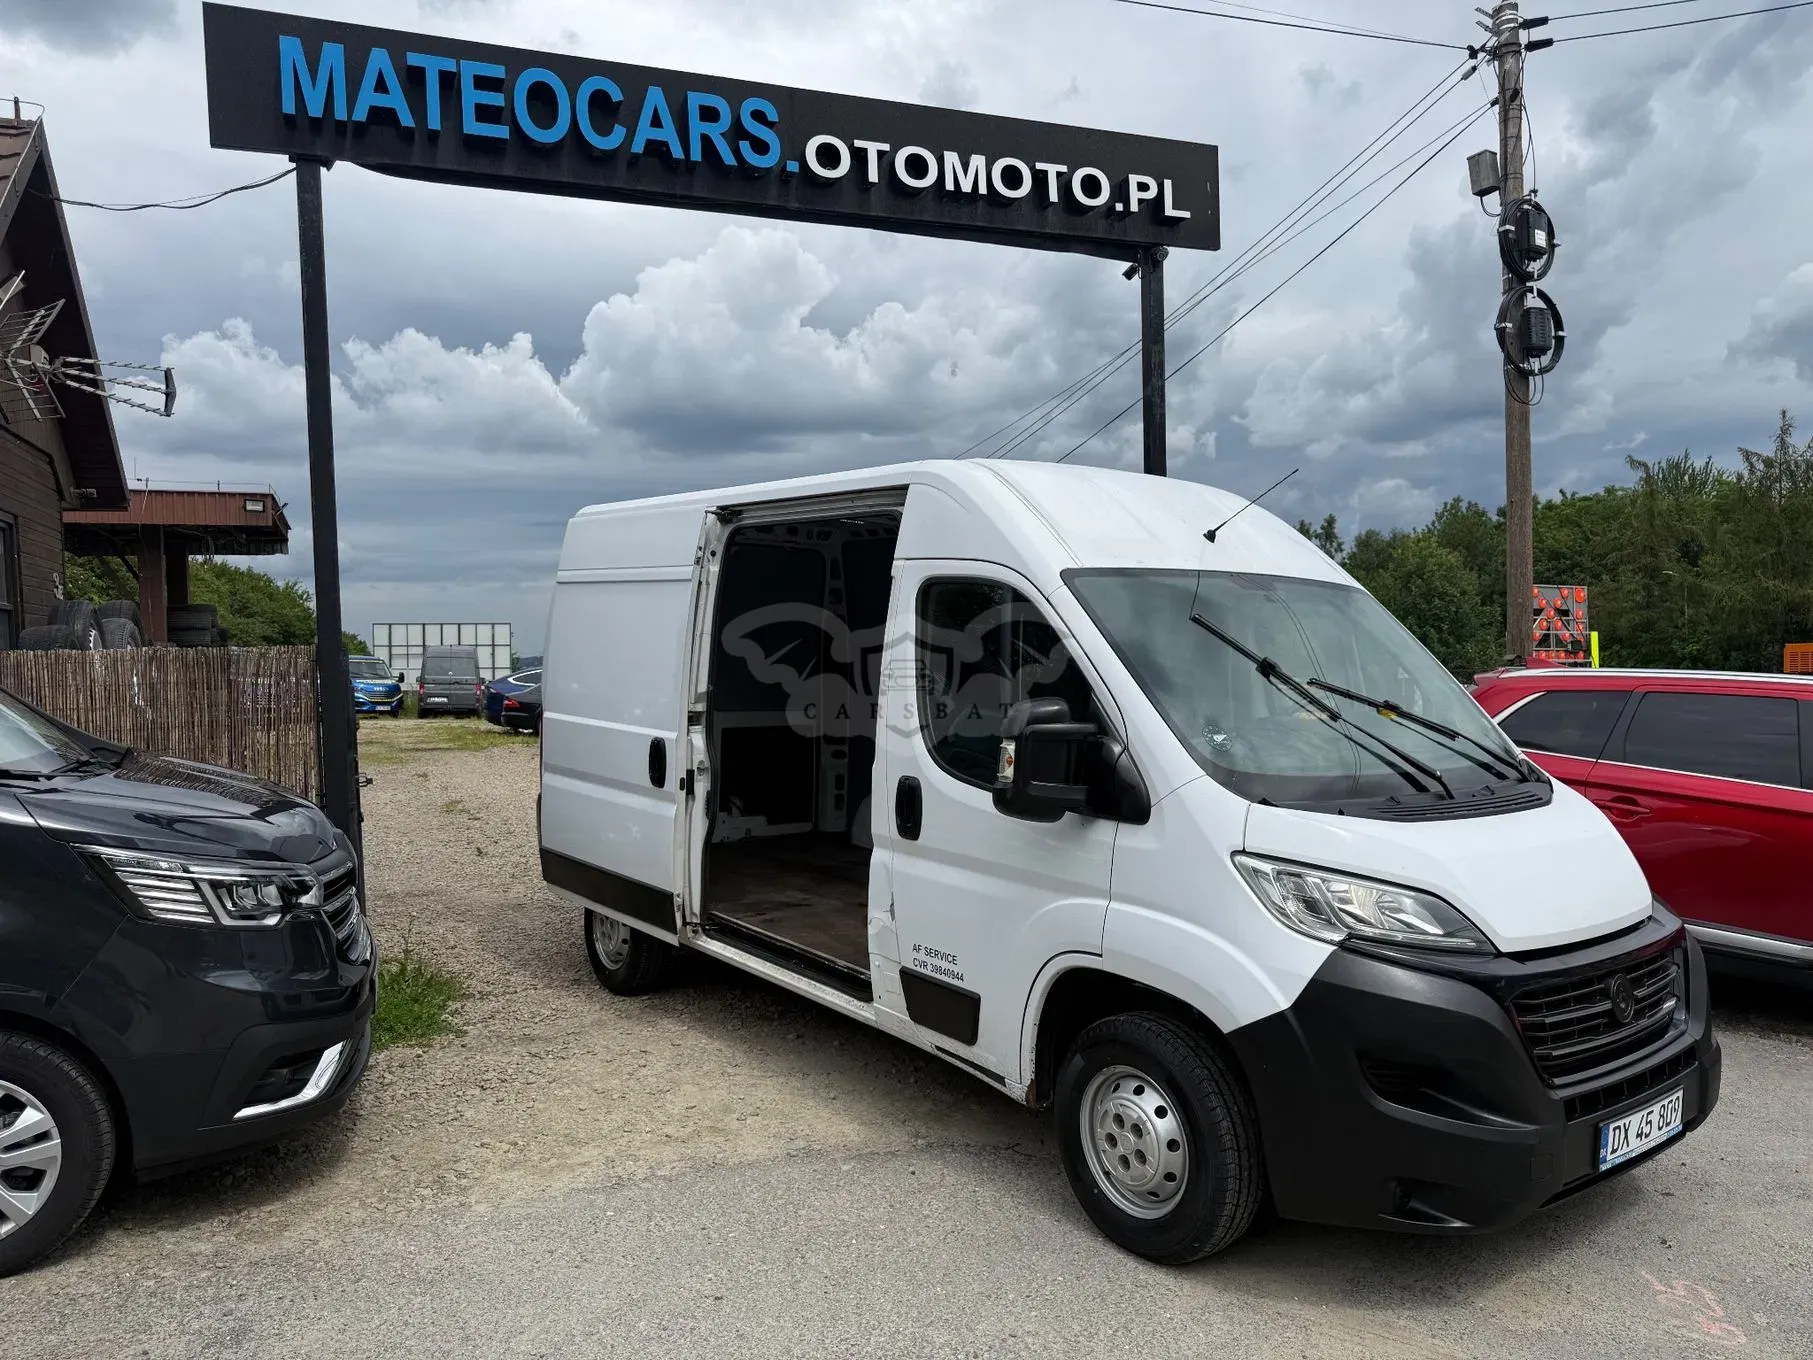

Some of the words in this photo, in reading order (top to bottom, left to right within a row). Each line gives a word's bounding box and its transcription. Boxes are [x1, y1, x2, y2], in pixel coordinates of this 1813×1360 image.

[912, 943, 922, 953] AF
[924, 946, 958, 965] SERVICE
[912, 957, 929, 971] CVR
[930, 963, 964, 983] 39840944
[1610, 1119, 1632, 1155] DX
[1636, 1109, 1654, 1142] 45
[1657, 1095, 1680, 1132] 809
